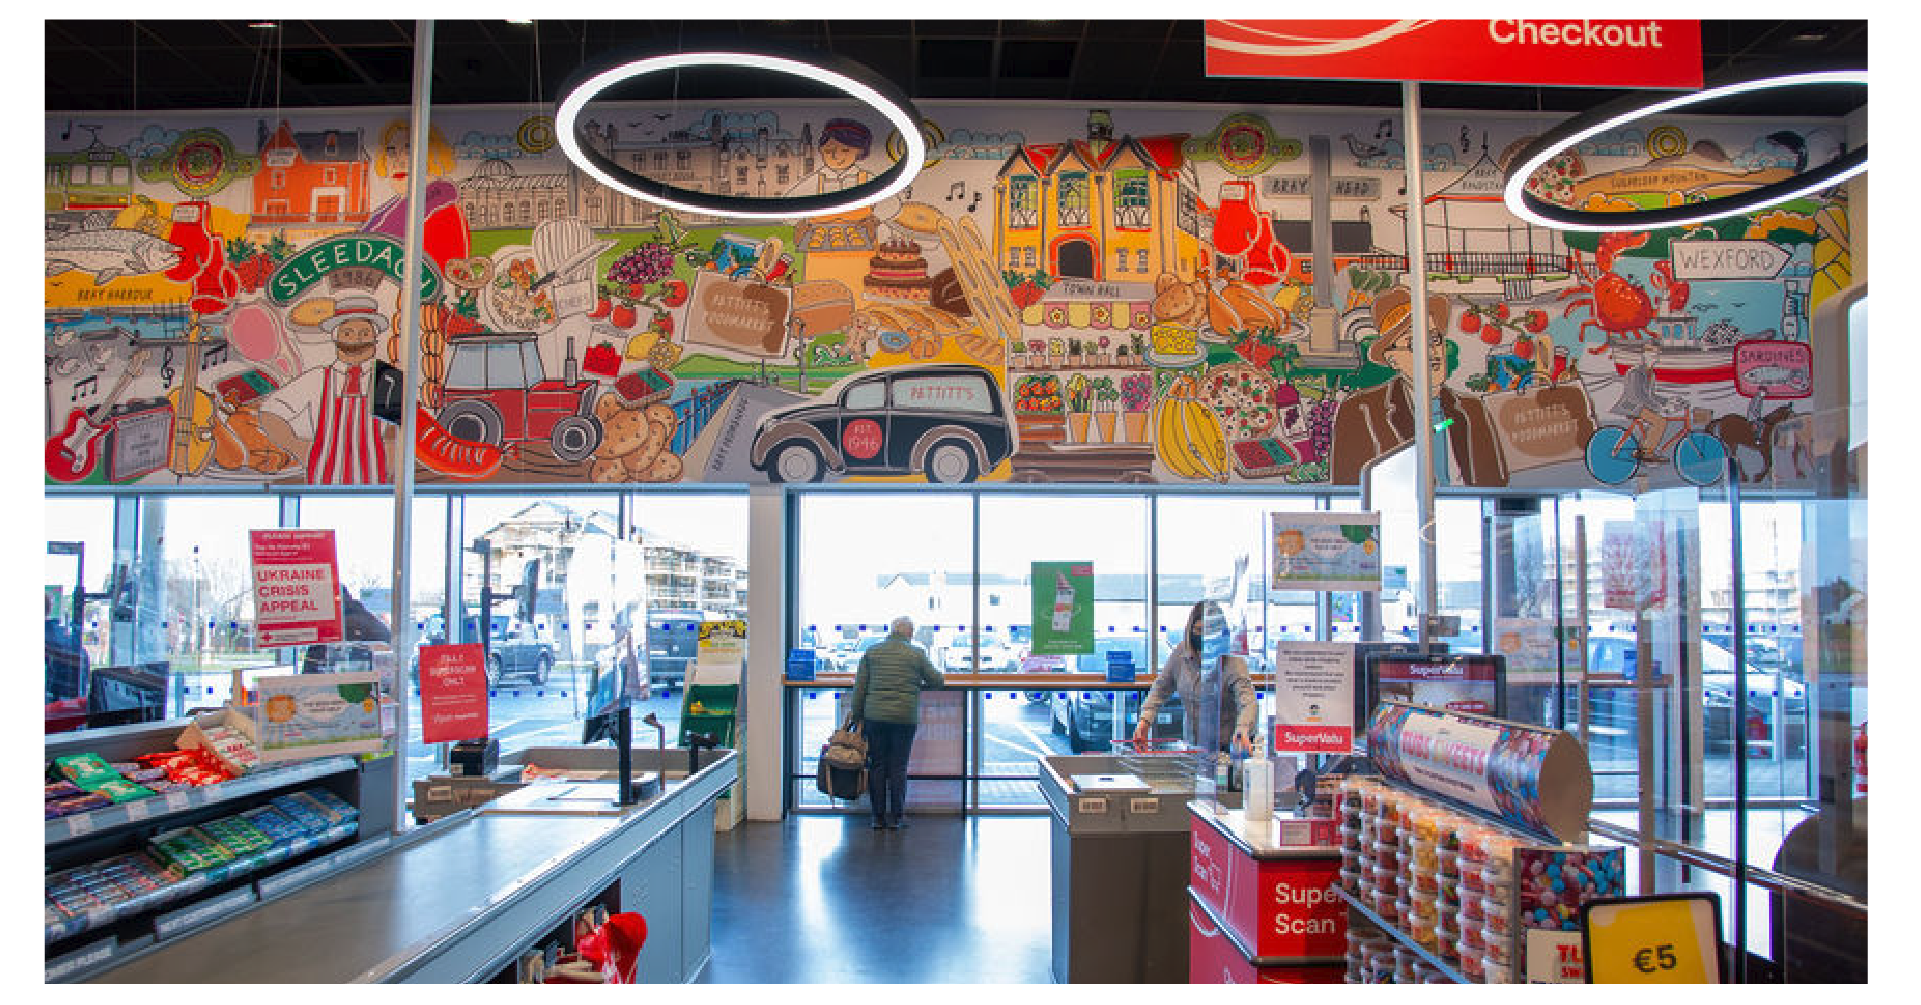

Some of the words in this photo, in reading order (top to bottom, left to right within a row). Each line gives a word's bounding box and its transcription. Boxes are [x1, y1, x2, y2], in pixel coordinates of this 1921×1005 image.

[1488, 19, 1662, 48] Checkout
[1271, 176, 1308, 193] BRAY
[1679, 249, 1775, 271] WEXFORD
[106, 288, 154, 301] HARBOUR
[1064, 283, 1094, 295] TOWN
[1739, 348, 1804, 364] SARDINES
[847, 435, 879, 452] 1946
[257, 568, 326, 582] UKRAINE
[258, 585, 309, 598] CRISIS
[260, 599, 319, 613] APPEAL
[1283, 731, 1343, 747] SuperValu
[1275, 913, 1336, 935] Scan
[1633, 942, 1677, 974] €5
